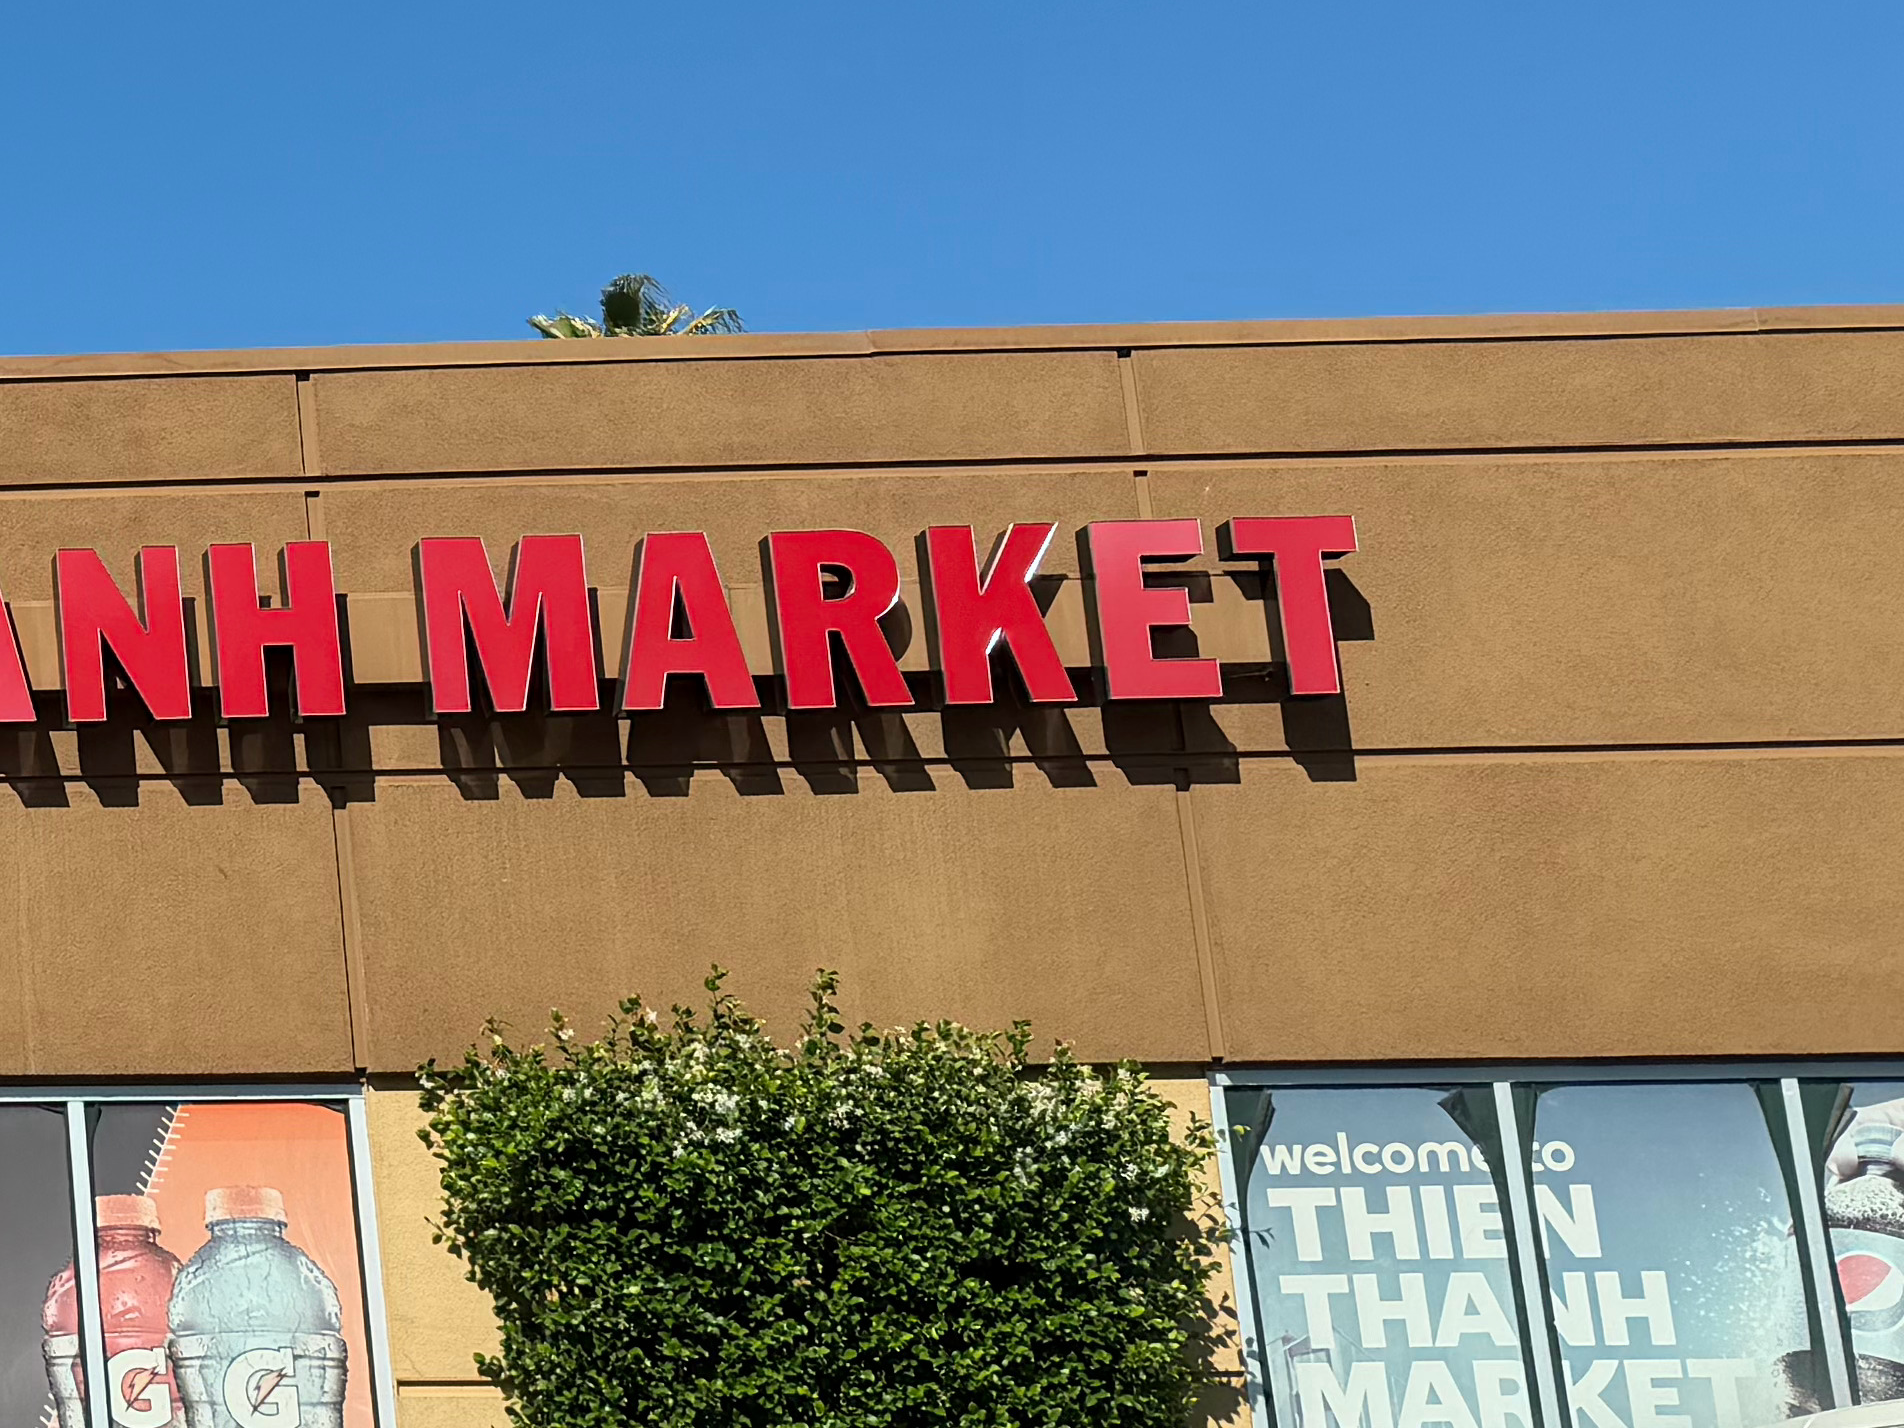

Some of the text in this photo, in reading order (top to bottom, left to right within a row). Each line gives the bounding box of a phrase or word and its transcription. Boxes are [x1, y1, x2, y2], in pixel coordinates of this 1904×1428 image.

[420, 515, 1357, 712] MARKET
[1267, 1184, 1602, 1261] THIEN
[1279, 1270, 1677, 1348] THANH
